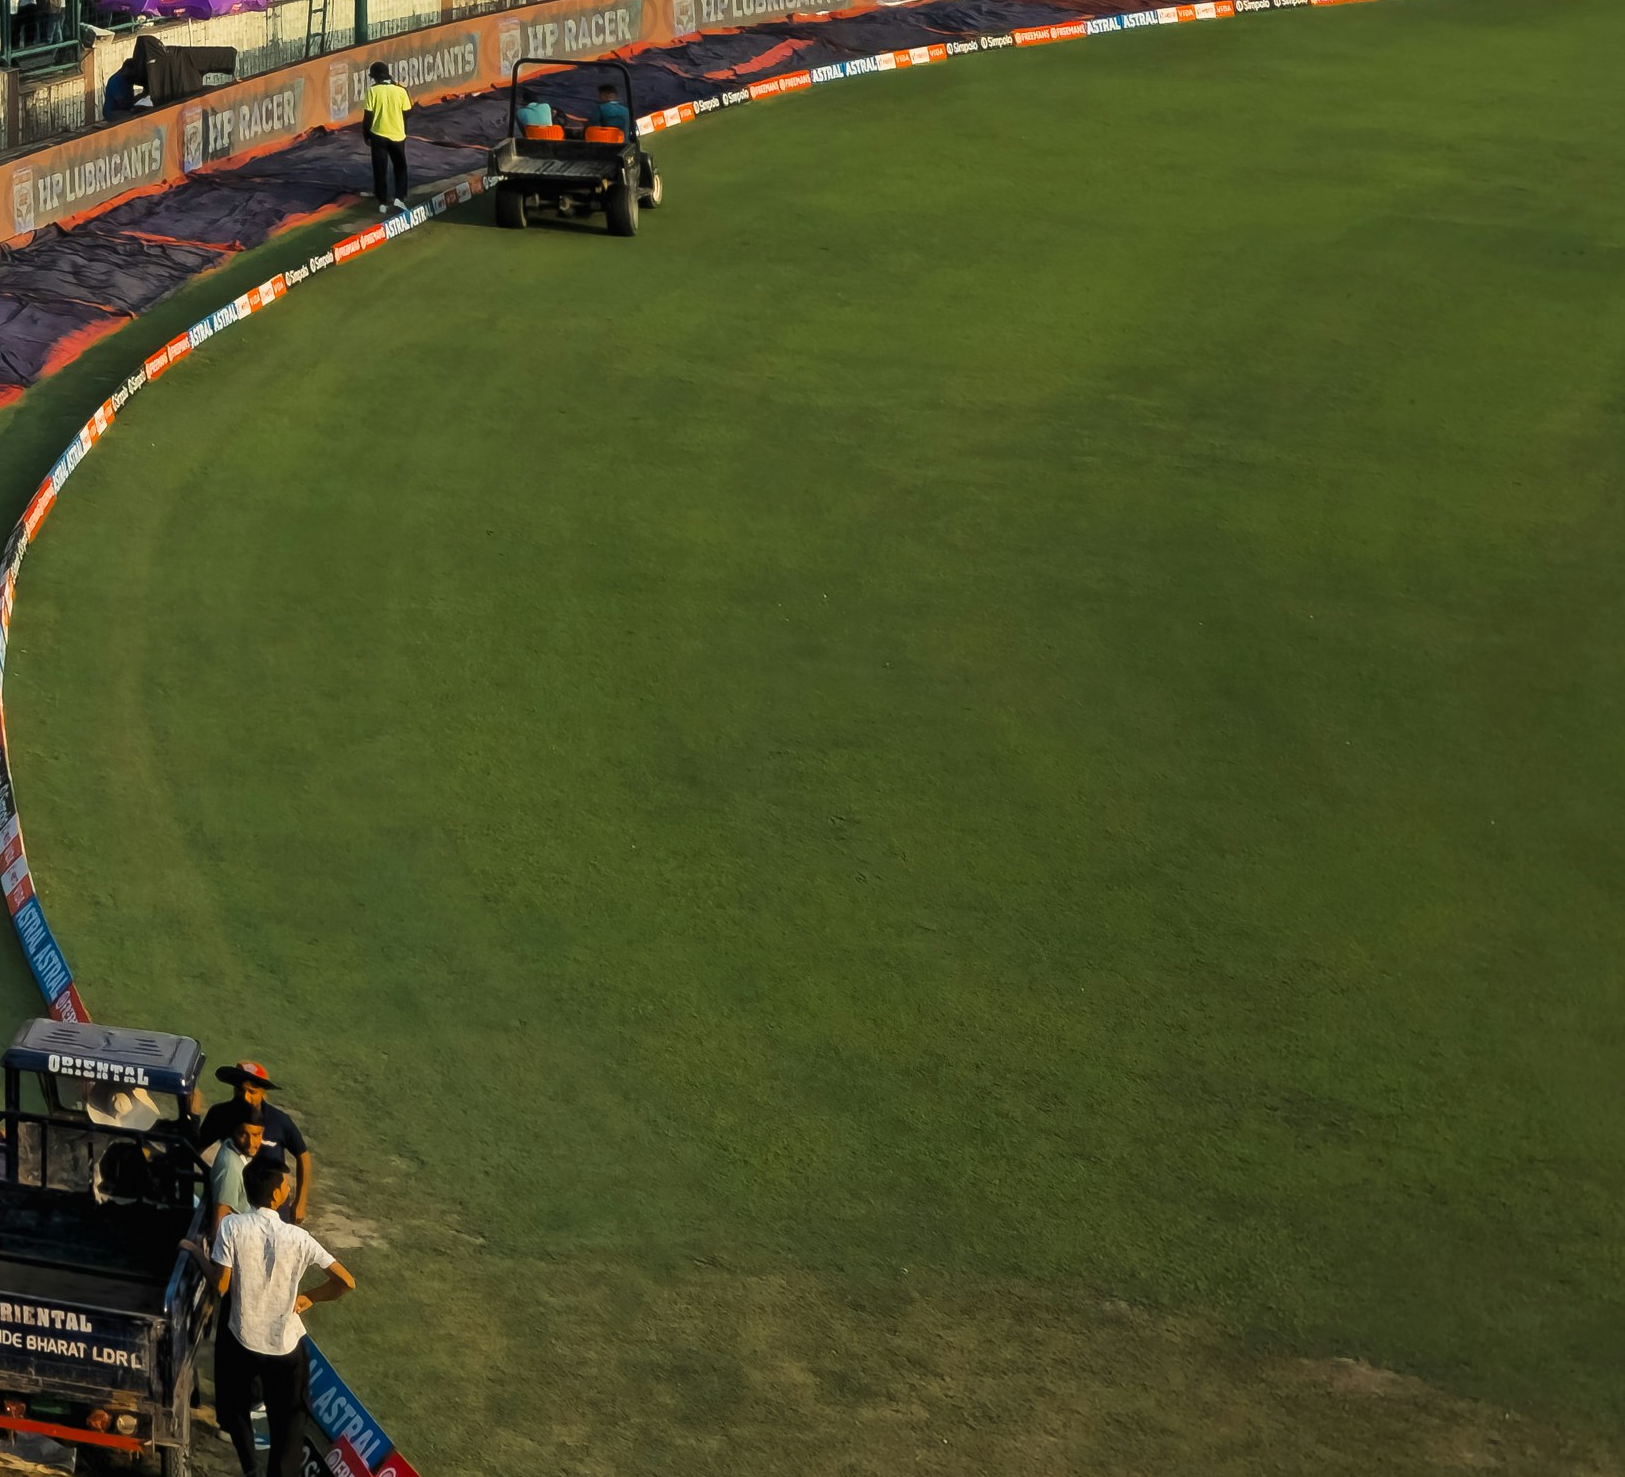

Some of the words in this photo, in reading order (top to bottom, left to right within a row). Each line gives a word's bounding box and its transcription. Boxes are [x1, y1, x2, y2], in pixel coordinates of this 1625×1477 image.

[1123, 11, 1157, 29] ASTRAL
[1243, 0, 1270, 11] Simpolo
[527, 22, 559, 58] HP
[563, 8, 631, 50] RACER
[1087, 17, 1121, 35] ASTRAL
[811, 63, 843, 83] ASTRAL
[845, 56, 878, 78] ASTRAL
[207, 108, 235, 147] HP
[238, 89, 296, 136] RACER
[37, 173, 64, 211] HP
[65, 138, 162, 202] LUBRICANTS
[15, 902, 47, 955] ASTRAL
[33, 943, 70, 1001] ASTRAL
[48, 1053, 150, 1086] ORIENTAL
[26, 1335, 87, 1360] BHARAT
[312, 1386, 381, 1468] ASTRAL
